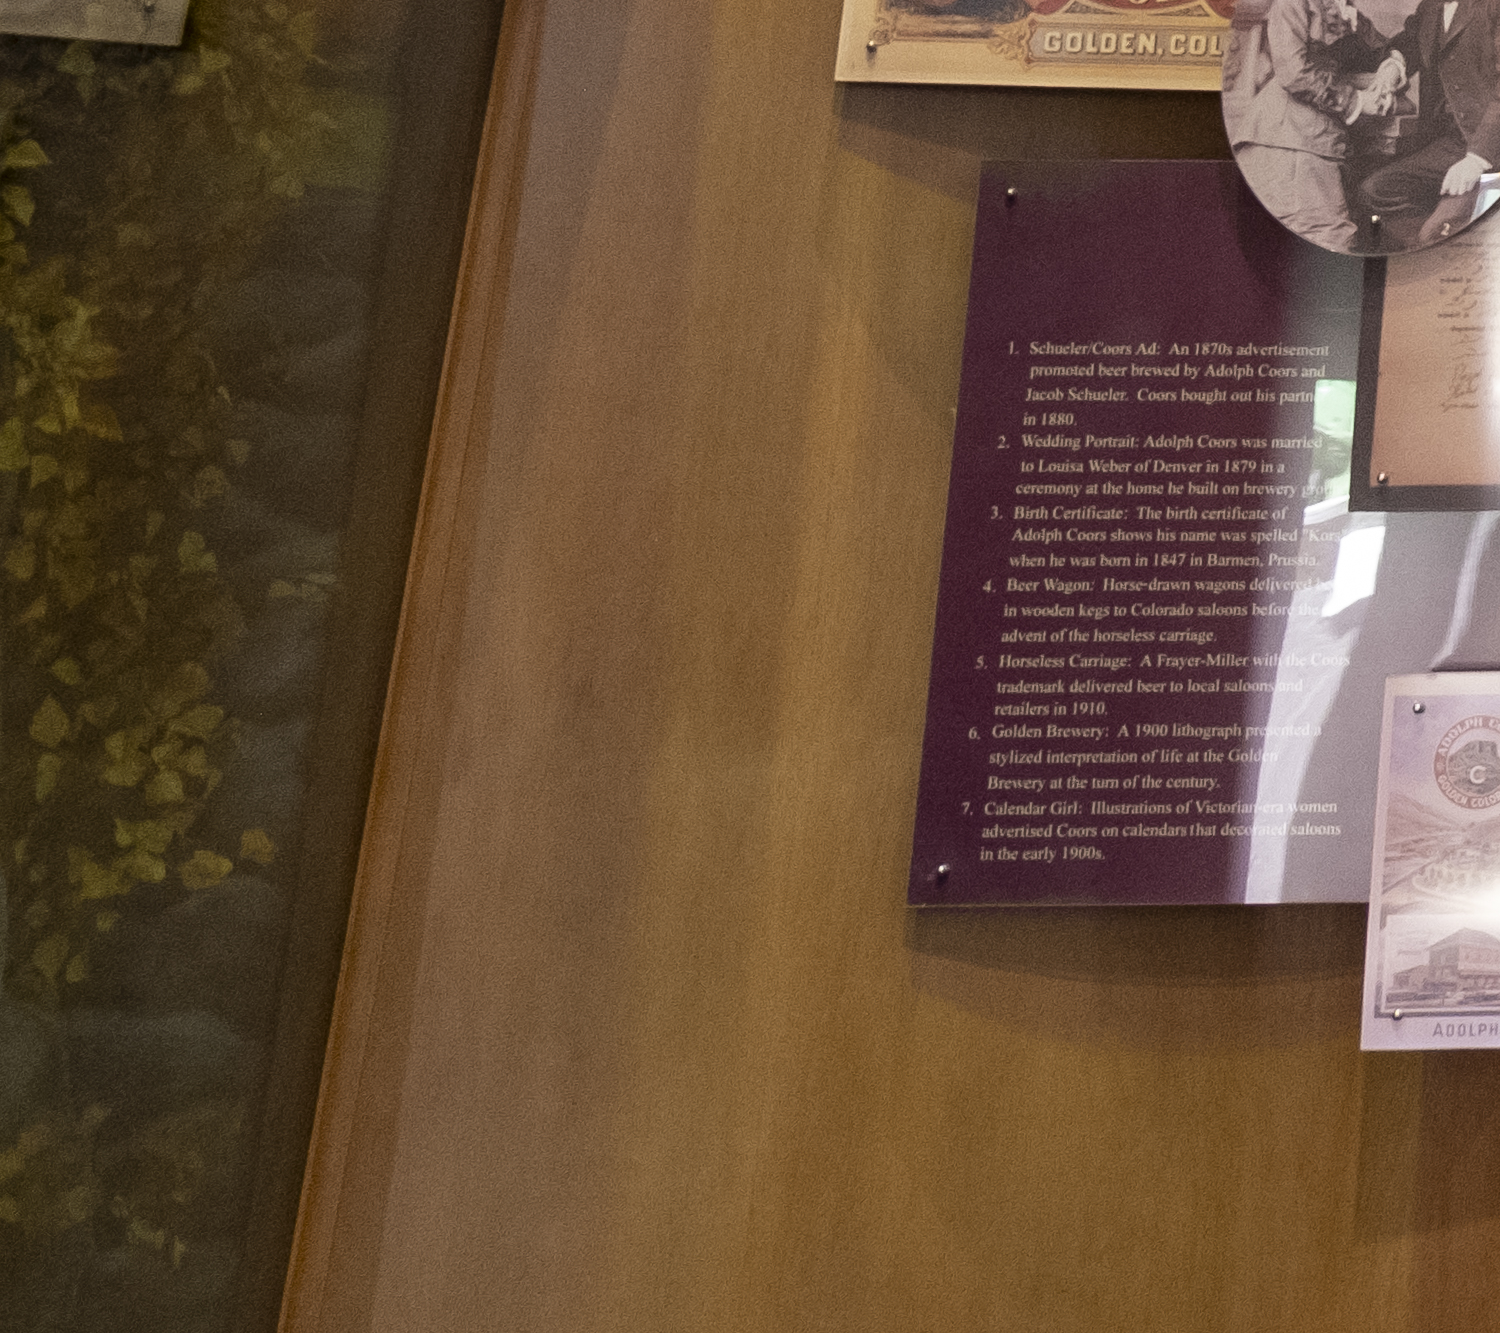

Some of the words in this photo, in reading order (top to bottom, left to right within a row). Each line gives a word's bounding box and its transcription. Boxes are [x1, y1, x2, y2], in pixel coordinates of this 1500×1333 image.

[1043, 31, 1164, 57] GOLDEN,
[1029, 341, 1132, 354] Schueler/Coors
[1136, 341, 1160, 355] Ad:
[1169, 342, 1189, 355] An
[1195, 342, 1232, 355] 1870s
[1237, 343, 1330, 356] advertisement
[1030, 364, 1094, 382] promoted
[1098, 364, 1126, 378] beer
[1131, 364, 1180, 378] brewed
[1184, 365, 1199, 383] by
[1205, 365, 1254, 383] Adolph
[1258, 365, 1298, 379] Coors
[1301, 365, 1327, 379] and
[997, 435, 1010, 448] 2.
[1022, 435, 1081, 452] Wedding
[1085, 435, 1139, 449] Portrait:
[1144, 436, 1193, 453] Adolph
[1197, 436, 1237, 449] Coors
[1242, 440, 1267, 449] was
[1271, 436, 1323, 449] married
[990, 506, 1002, 519] 3.
[1014, 506, 1048, 519] Birth
[1052, 506, 1128, 519] Certificate:
[1137, 506, 1162, 519] The
[1166, 506, 1197, 519] birth
[1201, 506, 1270, 519] certificate
[1270, 506, 1288, 519] of
[994, 702, 1049, 715] retailers
[1053, 702, 1067, 715] in
[1073, 702, 1108, 715] 1910.
[1437, 715, 1484, 757] ADOLPH
[987, 776, 1044, 793] Brewery
[1050, 776, 1062, 789] at
[1067, 776, 1087, 789] the
[1092, 775, 1119, 789] turn
[1123, 775, 1137, 789] of
[1142, 775, 1162, 789] the
[1166, 775, 1221, 792] century.
[1436, 774, 1469, 808] GOLDEN
[980, 846, 993, 859] in
[997, 846, 1018, 859] the
[1022, 846, 1056, 863] early
[1063, 846, 1105, 859] 1900s.
[1433, 1021, 1500, 1038] ADOLPH
